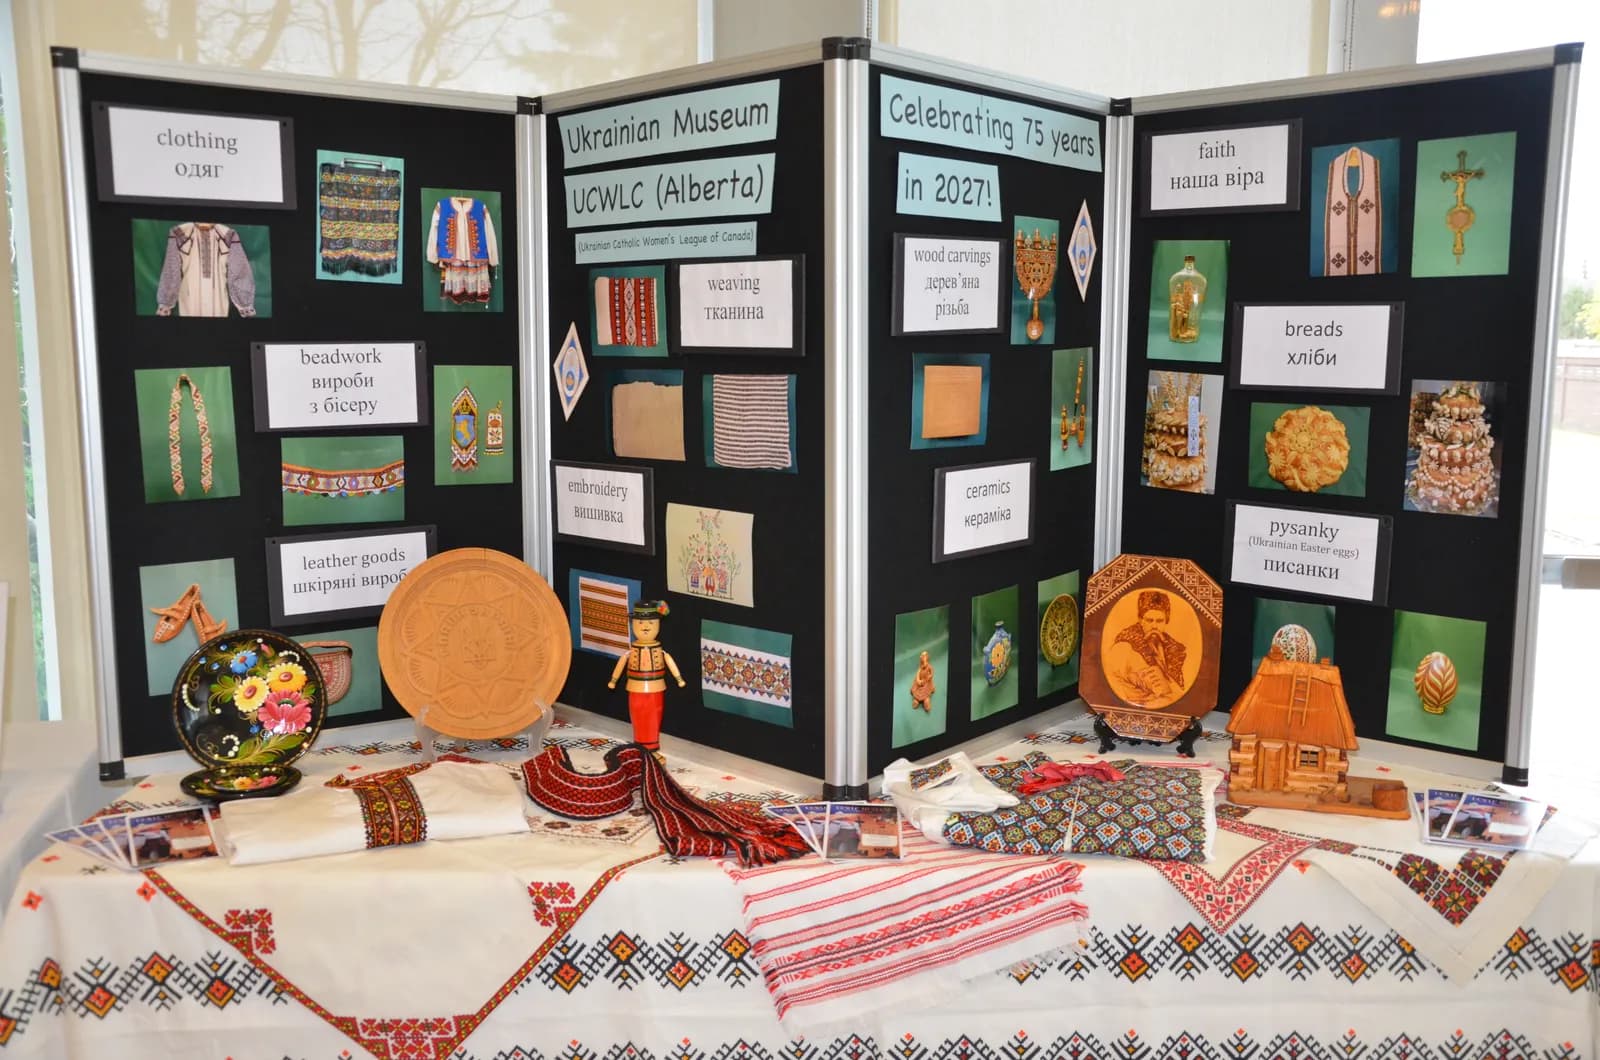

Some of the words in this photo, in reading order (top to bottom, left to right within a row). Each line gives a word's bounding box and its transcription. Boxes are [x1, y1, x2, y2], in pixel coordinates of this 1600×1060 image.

[567, 116, 660, 153] Ukrainian
[674, 102, 768, 137] Museum
[890, 94, 1013, 150] Celebrating
[1023, 118, 1044, 146] 75
[1051, 128, 1094, 157] years
[157, 128, 238, 155] clothing
[1198, 140, 1236, 159] faith
[174, 161, 224, 179] одяг
[1171, 173, 1219, 190] наша
[1225, 167, 1264, 190] віра
[573, 182, 644, 213] UCWLC
[657, 164, 763, 210] (Alberta)
[905, 170, 922, 200] in
[935, 174, 992, 206] 2027!
[578, 241, 611, 253] (Ukrainian
[613, 237, 640, 249] Catholic
[680, 235, 707, 247] League
[710, 232, 719, 242] of
[722, 230, 753, 242] Canada)
[914, 247, 945, 263] wood
[948, 249, 991, 267] carvings
[708, 273, 760, 294] weaving
[704, 306, 764, 320] тканина
[935, 298, 969, 320] різьба
[1286, 320, 1343, 337] breads
[301, 348, 382, 365] beadwork
[1287, 349, 1337, 366] хліби
[312, 372, 374, 392] вироби
[310, 401, 318, 414] з
[324, 397, 378, 416] бісеру
[568, 478, 628, 502] embroidery
[967, 480, 1010, 498] ceramics
[574, 506, 624, 523] вишивка
[965, 507, 1011, 528] кераміка
[1270, 521, 1340, 542] pysanky
[1249, 536, 1297, 550] (Ukrainian
[1300, 542, 1331, 554] Easter
[1333, 548, 1359, 559] eggs)
[302, 553, 357, 571] leather
[361, 547, 406, 568] goods
[1264, 559, 1340, 579] писанки
[293, 573, 356, 594] шкіряні
[362, 569, 408, 589] вироб
